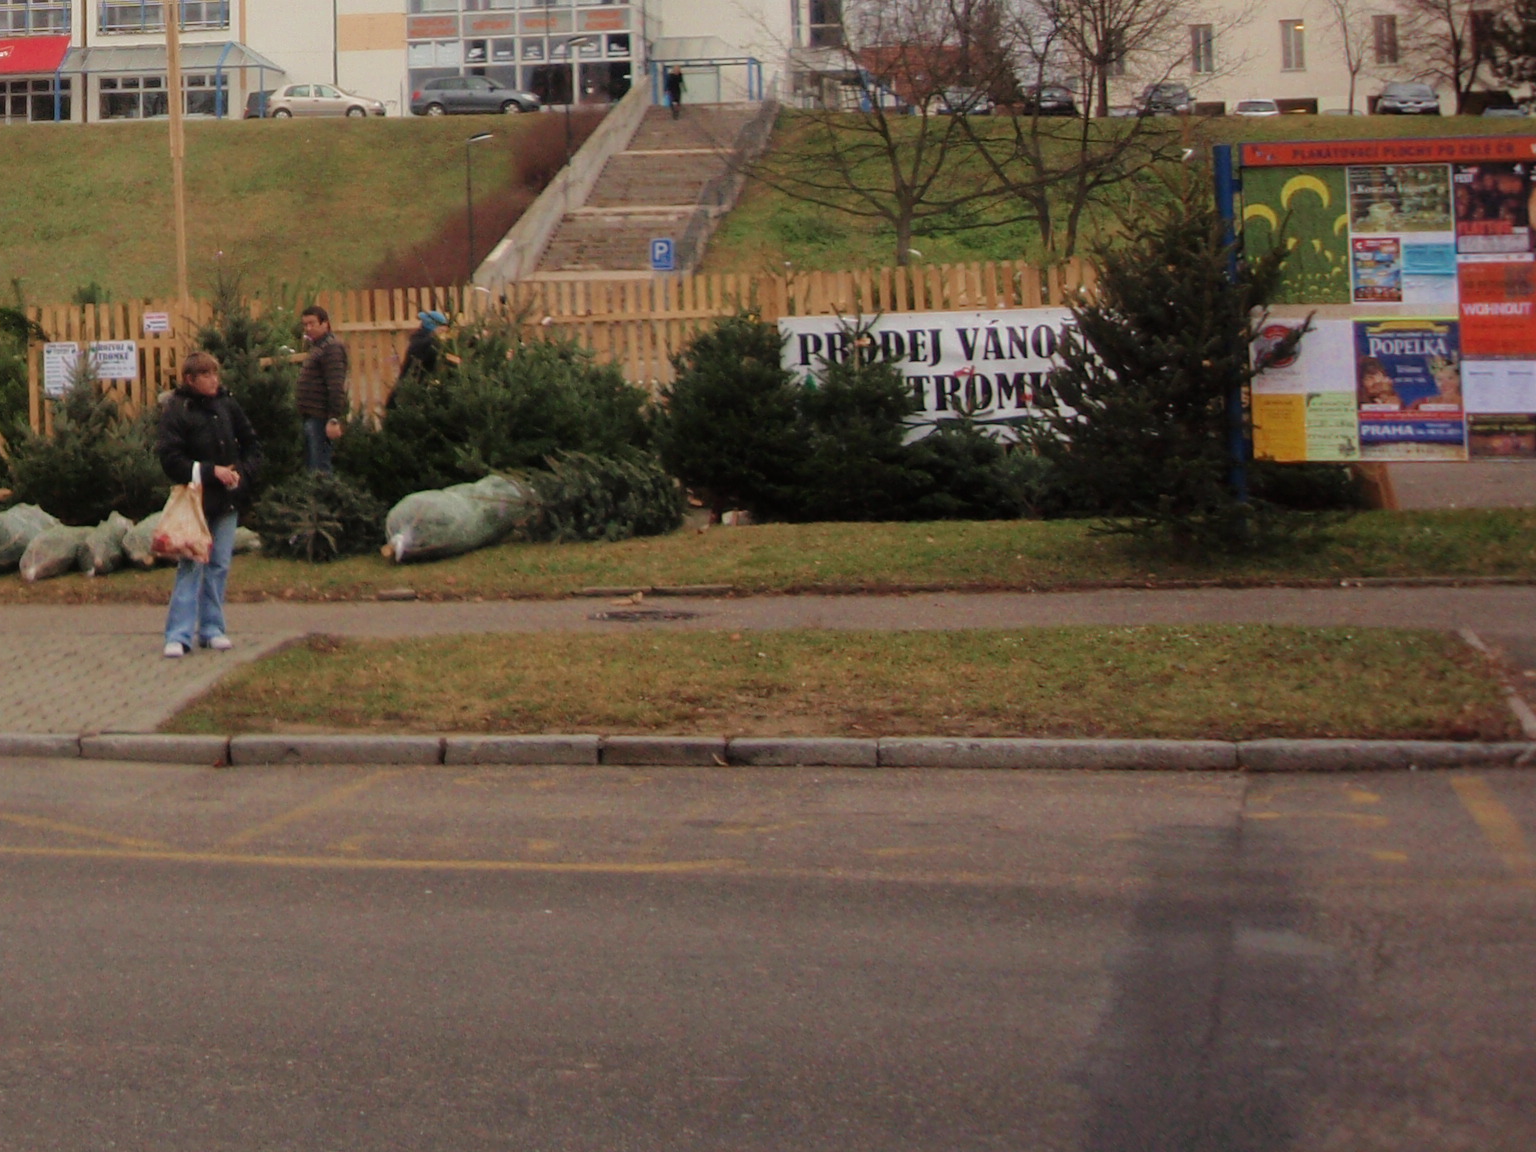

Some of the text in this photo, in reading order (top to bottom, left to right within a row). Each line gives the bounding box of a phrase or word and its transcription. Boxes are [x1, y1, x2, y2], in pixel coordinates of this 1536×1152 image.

[655, 242, 668, 260] P
[1461, 302, 1532, 315] WOHNOUT
[1368, 337, 1448, 357] POPELKA
[1360, 424, 1414, 436] PRAHA
